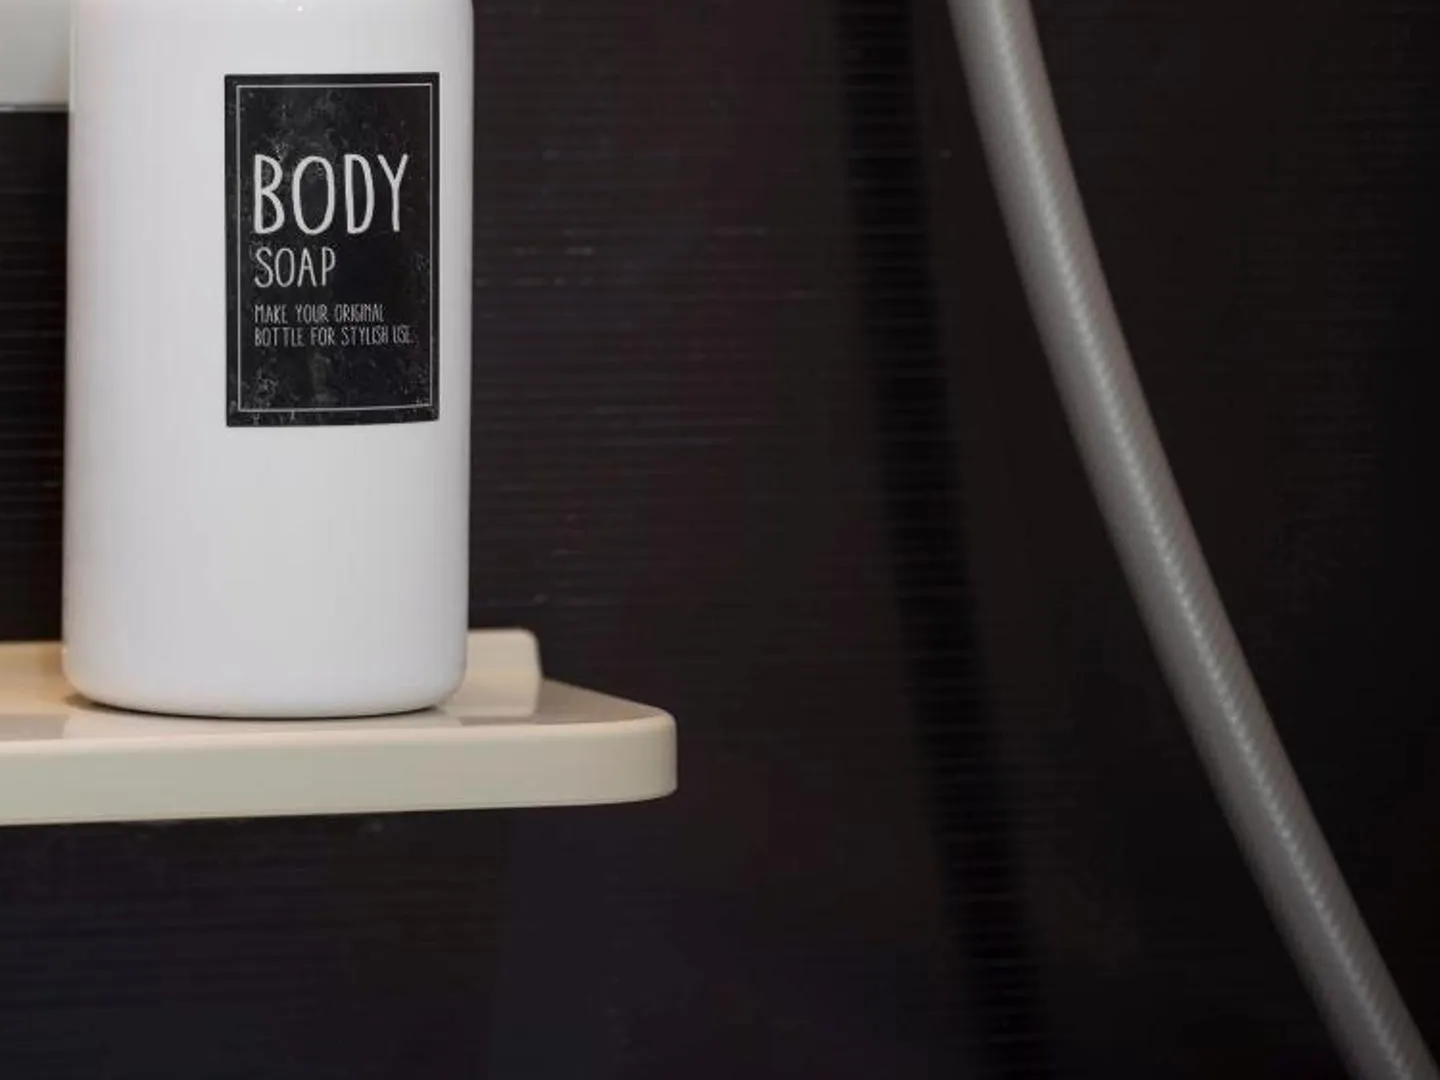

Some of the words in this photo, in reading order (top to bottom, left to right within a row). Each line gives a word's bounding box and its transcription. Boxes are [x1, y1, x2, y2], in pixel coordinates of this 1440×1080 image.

[254, 153, 409, 234] BODY
[254, 246, 336, 288] SOAP
[254, 304, 288, 323] MAKE
[295, 304, 329, 323] YOUR
[334, 303, 384, 322] ORIGINAL
[254, 327, 305, 347] BOTTLE
[311, 326, 335, 346] FOR
[341, 325, 389, 346] STYLISH
